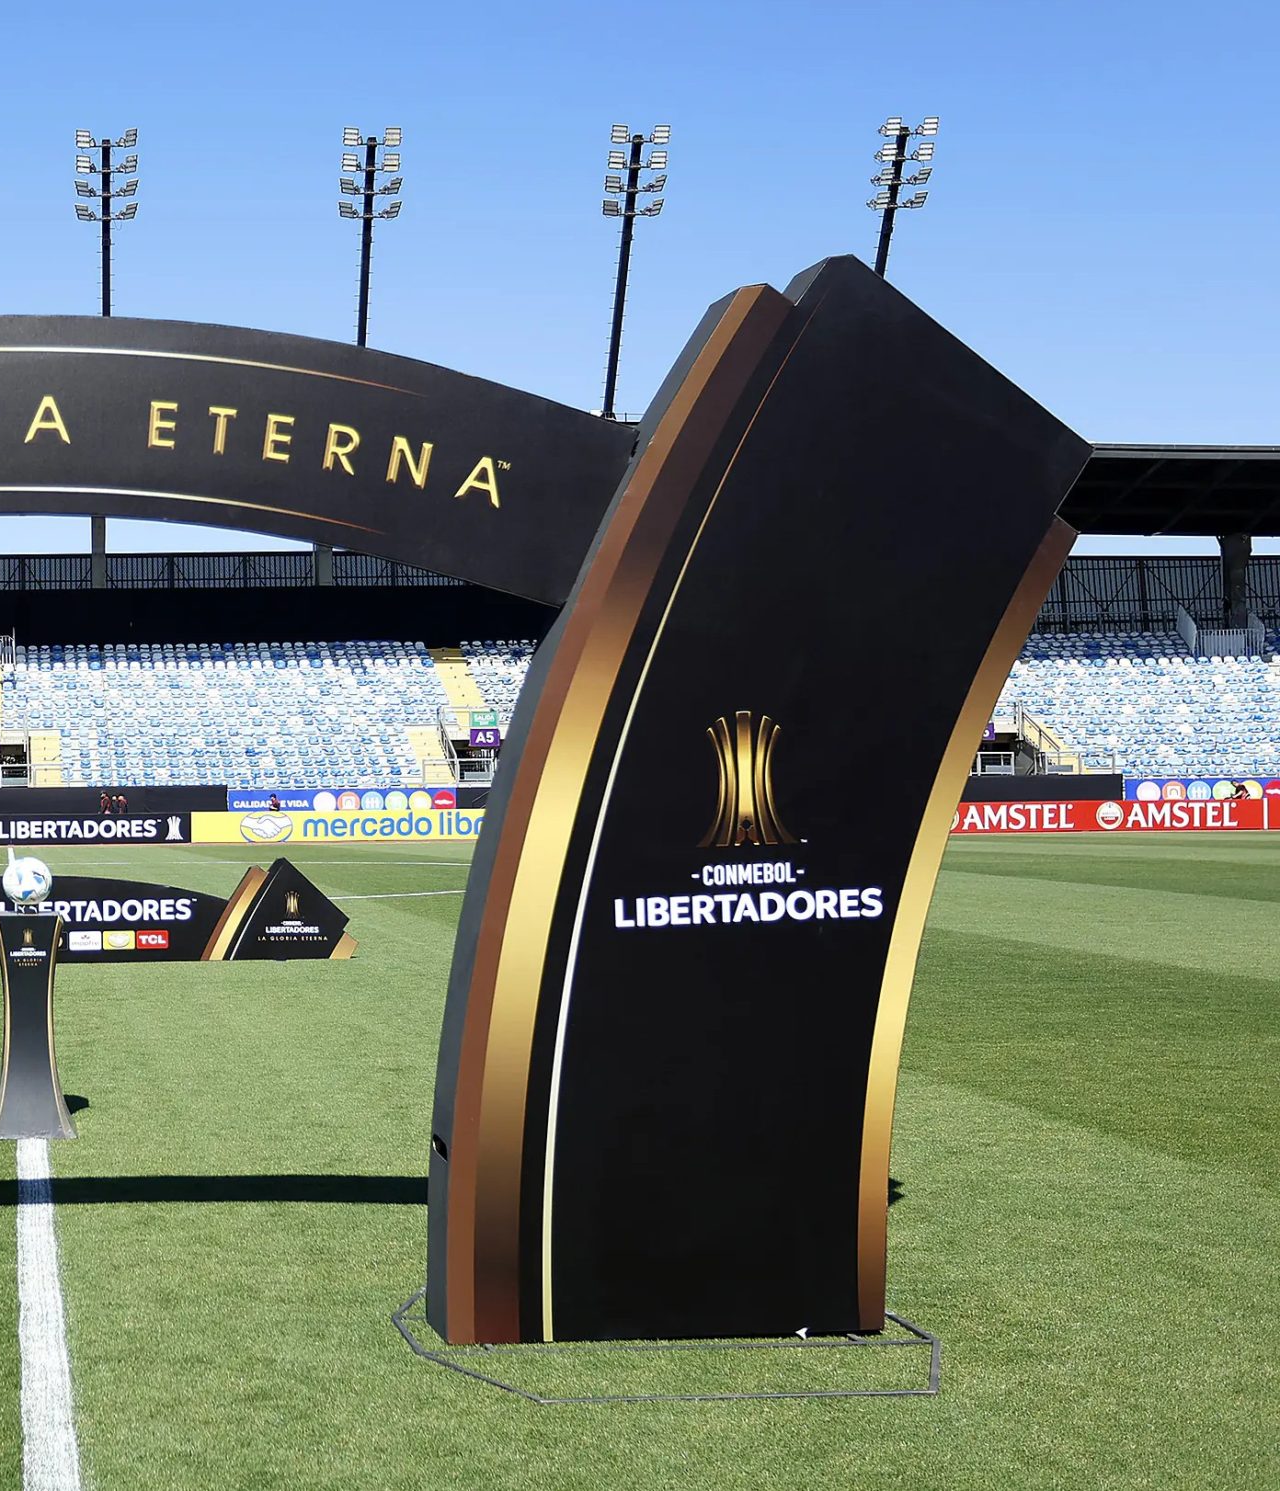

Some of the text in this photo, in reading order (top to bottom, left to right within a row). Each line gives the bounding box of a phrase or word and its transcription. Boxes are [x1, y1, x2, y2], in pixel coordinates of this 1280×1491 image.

[475, 731, 495, 744] A5
[287, 799, 310, 808] VIDA
[1125, 802, 1239, 829] AMSTEL
[303, 811, 432, 837] mercado
[962, 803, 1075, 831] AMSTEL
[614, 888, 883, 928] LIBERTADORES
[138, 934, 167, 945] TCL
